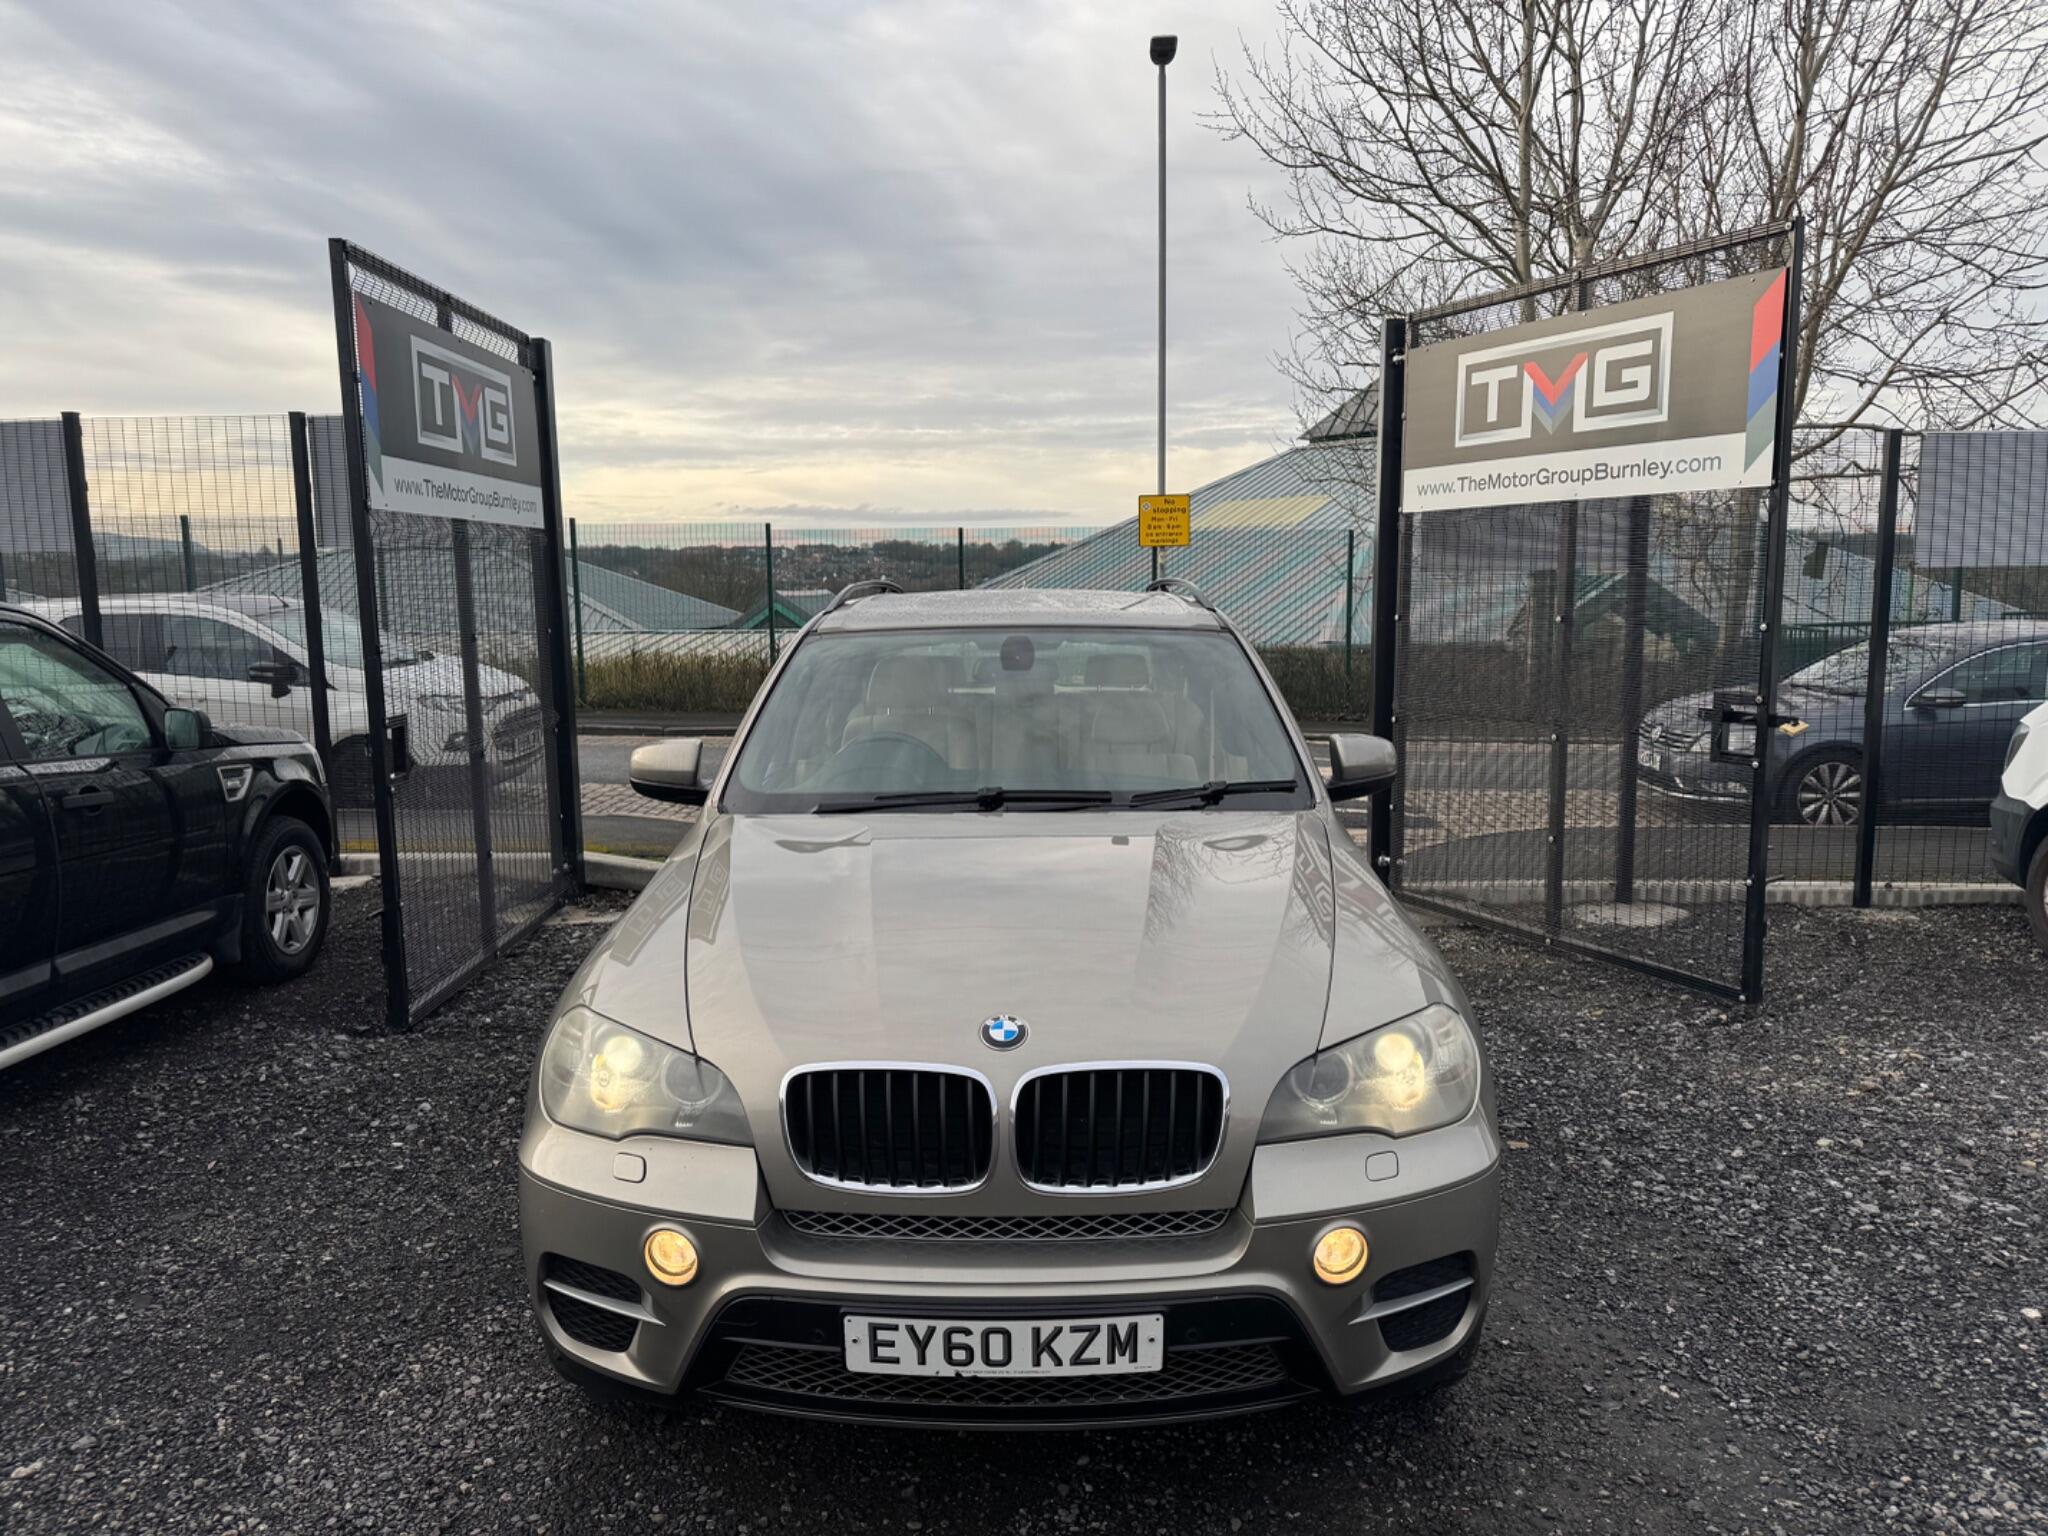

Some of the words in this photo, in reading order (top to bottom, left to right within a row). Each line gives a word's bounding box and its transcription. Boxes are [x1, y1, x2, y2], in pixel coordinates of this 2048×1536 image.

[419, 358, 511, 456] TMG
[1468, 336, 1655, 438] TMG
[393, 477, 538, 514] www.TheMotorGroupBurnley.com
[1416, 452, 1722, 497] www.TheMotorGroupBurnley.com
[1152, 506, 1187, 514] stopping
[867, 1321, 1013, 1367] EY60
[1030, 1321, 1139, 1367] KZM
